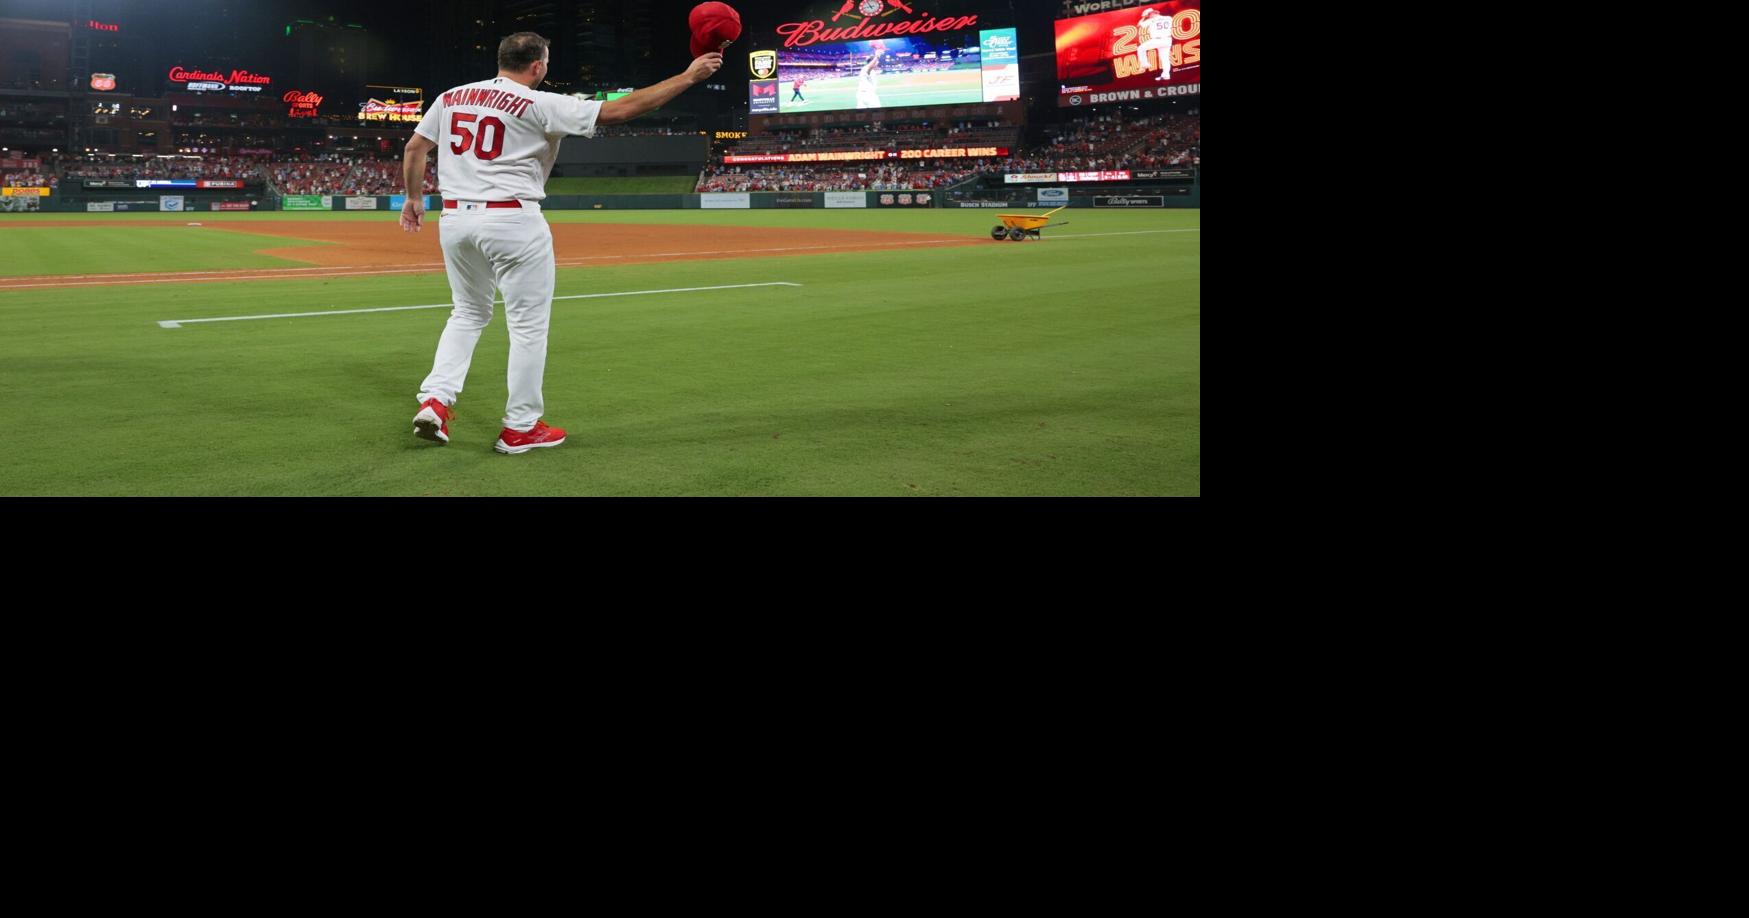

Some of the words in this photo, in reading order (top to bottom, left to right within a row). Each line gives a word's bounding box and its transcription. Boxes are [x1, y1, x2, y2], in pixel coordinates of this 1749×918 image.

[776, 12, 978, 47] Budweiser
[169, 66, 224, 82] Cardinals
[223, 69, 270, 85] Nation
[283, 90, 323, 106] Bally
[1089, 89, 1140, 103] BROWN
[1144, 90, 1153, 98] &
[1157, 83, 1200, 97] CROU
[442, 88, 534, 118] WAINWRIGHT
[358, 112, 387, 121] BREW
[389, 113, 423, 122] HOUSE
[450, 112, 505, 160] 50
[788, 153, 817, 162] ADAM
[818, 151, 885, 161] WAINWRIGHT
[901, 150, 922, 159] 200
[924, 149, 966, 158] CAREER
[967, 147, 997, 157] WINS
